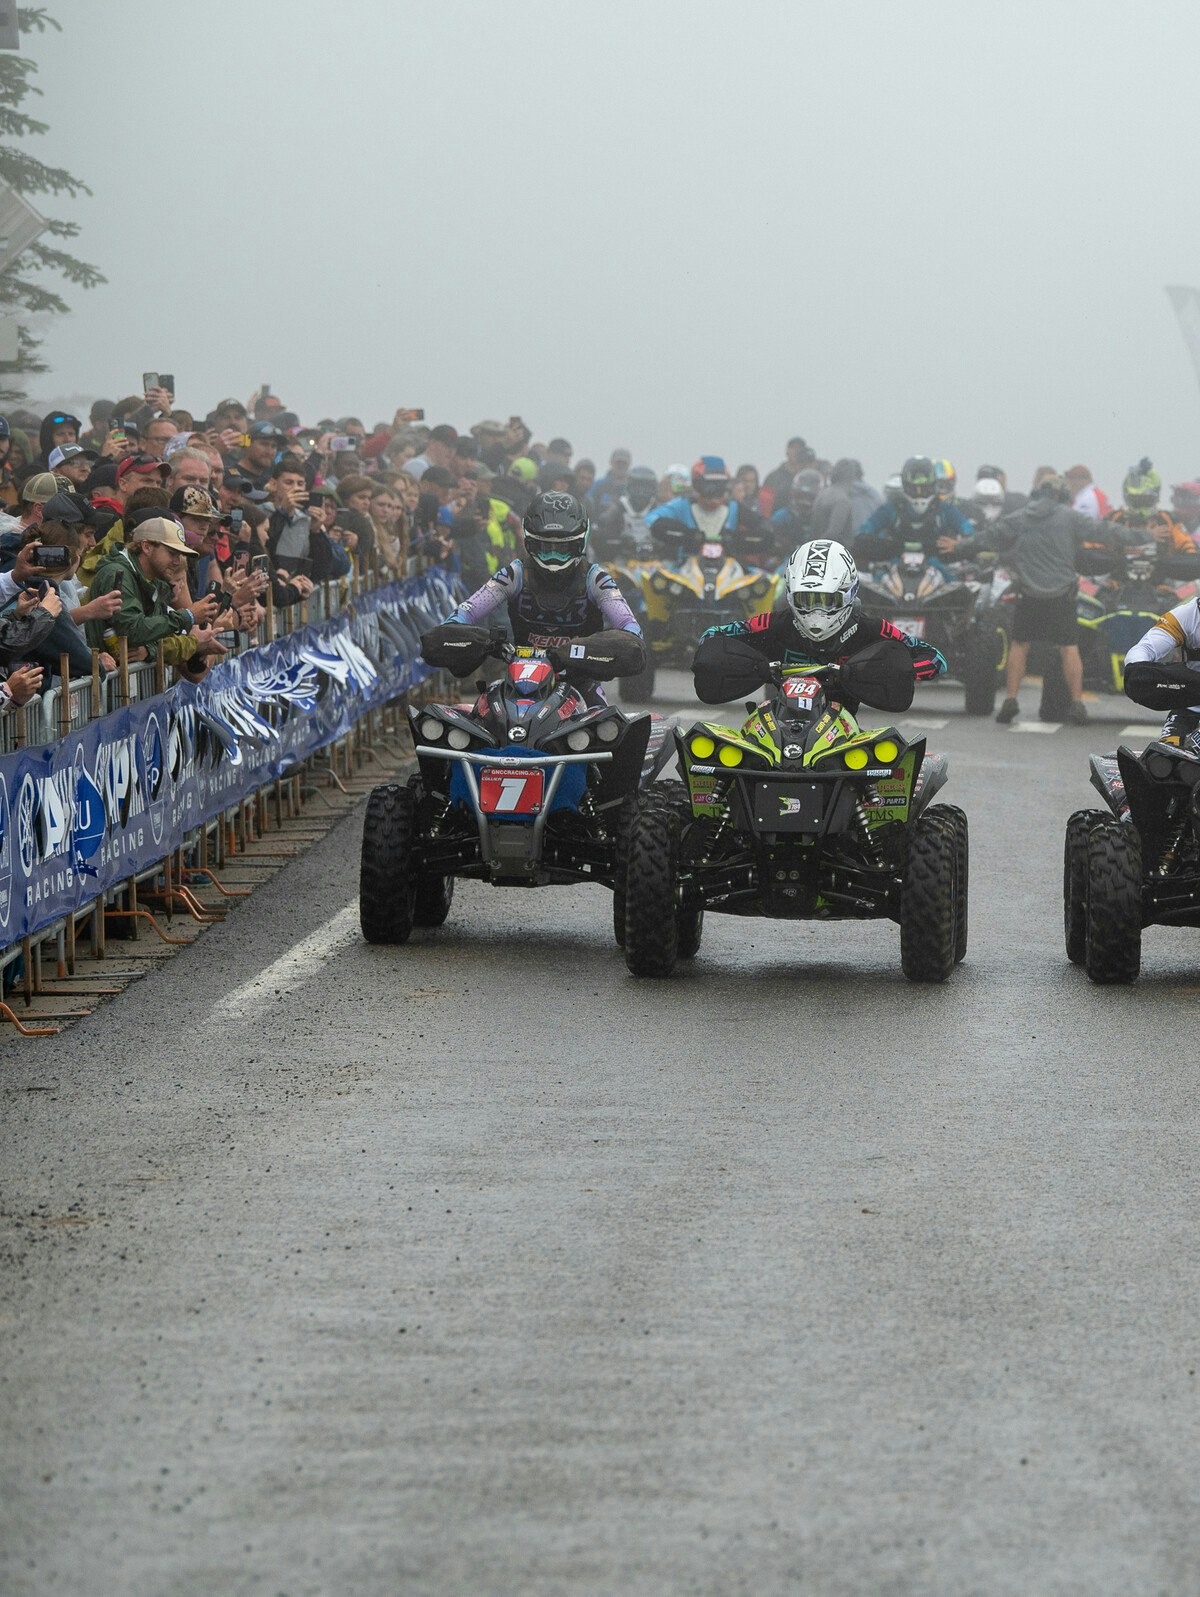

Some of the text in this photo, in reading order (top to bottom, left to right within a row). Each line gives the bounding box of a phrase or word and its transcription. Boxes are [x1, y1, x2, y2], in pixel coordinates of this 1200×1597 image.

[528, 633, 572, 648] KEND
[839, 623, 859, 643] LEATT
[519, 664, 539, 680] 1
[786, 683, 817, 697] 784
[495, 777, 528, 811] 1
[867, 809, 895, 820] TMS
[101, 828, 144, 867] RACING
[26, 867, 73, 907] RACING
